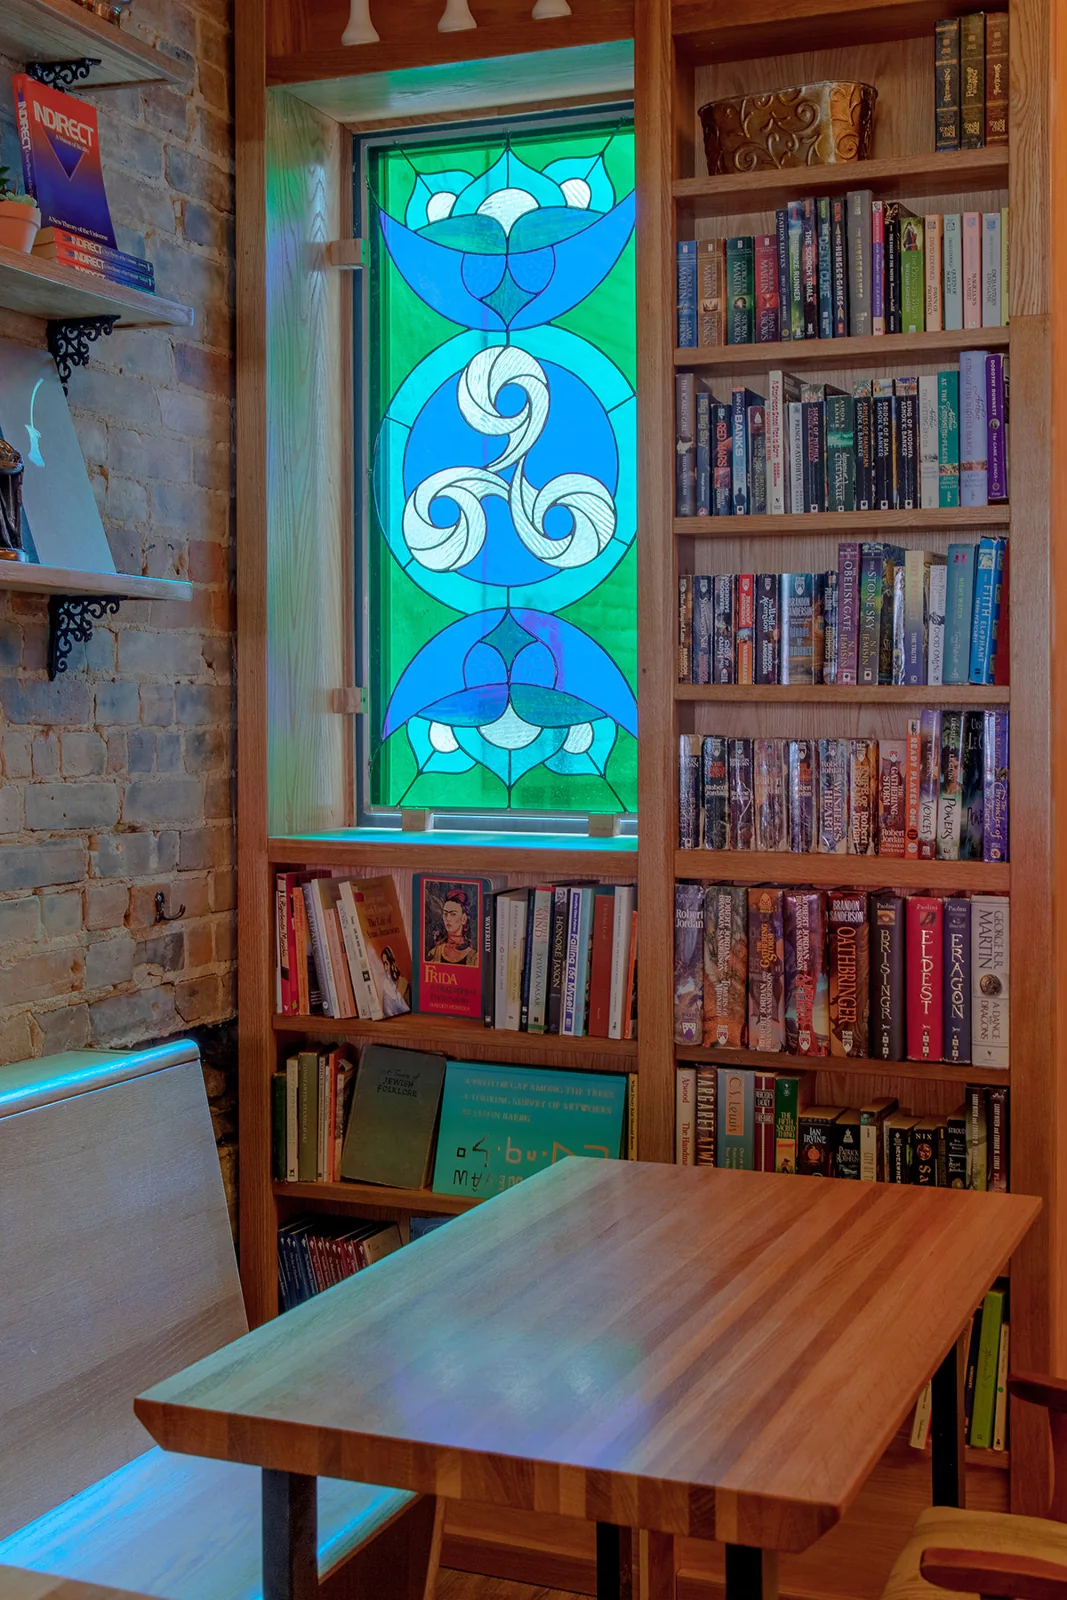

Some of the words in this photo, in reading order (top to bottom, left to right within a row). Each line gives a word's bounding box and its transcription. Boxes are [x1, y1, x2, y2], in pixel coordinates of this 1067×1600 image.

[18, 101, 31, 151] INDIRECT
[33, 100, 94, 146] INDIRECT
[71, 236, 102, 254] INDIRECT
[819, 237, 829, 268] DEATH
[74, 251, 104, 269] INDIRECT
[835, 246, 843, 277] HUNGER
[679, 266, 687, 299] MARTIN
[704, 265, 712, 297] MARTIN
[760, 260, 768, 293] MARTIN
[820, 271, 830, 299] CURE
[704, 316, 712, 345] KINGS
[699, 399, 708, 413] Big
[699, 415, 708, 428] Big
[717, 423, 726, 440] RED
[735, 415, 743, 456] BANKS
[883, 428, 889, 436] OF
[907, 419, 912, 427] OF
[698, 430, 709, 447] Sky
[717, 442, 727, 466] MARS
[844, 561, 852, 604] OBELISK
[867, 571, 876, 607] STONE
[843, 606, 851, 631] GATE
[866, 610, 875, 630] SKY
[840, 634, 848, 667] JEMISIN
[824, 790, 833, 833] HEART
[833, 782, 841, 841] WINTER'S
[922, 800, 934, 835] VOICES
[940, 798, 956, 840] POWERS
[991, 782, 1006, 827] Chronicles
[853, 811, 862, 843] Jordan
[990, 830, 1000, 839] of
[676, 909, 703, 918] Robert
[830, 910, 864, 923] SANDERSON
[833, 900, 860, 910] BRANDON
[307, 910, 318, 949] NAIPAUL
[535, 908, 543, 938] MIND
[554, 916, 564, 957] HONORÉ
[676, 919, 703, 928] Jordan
[995, 910, 1003, 949] GEORGE
[569, 934, 579, 963] Falling
[760, 924, 768, 968] GATHERING
[768, 933, 776, 961] STORM
[979, 909, 992, 970] MARTIN
[424, 965, 458, 985] FRIDA
[535, 952, 543, 979] SYLVIA
[553, 959, 562, 988] JAXON
[836, 927, 857, 1024] OATHBRINGER
[881, 930, 892, 1019] BRISINGR
[920, 930, 934, 1014] ELDEST
[951, 934, 965, 1019] ERAGON
[566, 982, 576, 1013] Myself
[715, 983, 723, 1016] MIDNIGHT
[722, 980, 730, 1007] TOWERS
[981, 1000, 989, 1040] DRAGONS
[992, 1011, 1000, 1040] DANCE
[377, 1084, 418, 1097] FOLKLORE
[382, 1077, 414, 1088] JEWISH
[682, 1077, 690, 1103] Atwood
[682, 1122, 690, 1135] The
[729, 1102, 741, 1132] Lewis
[809, 1127, 821, 1136] IAN
[682, 1137, 690, 1166] Handma
[803, 1136, 826, 1144] IRVINE
